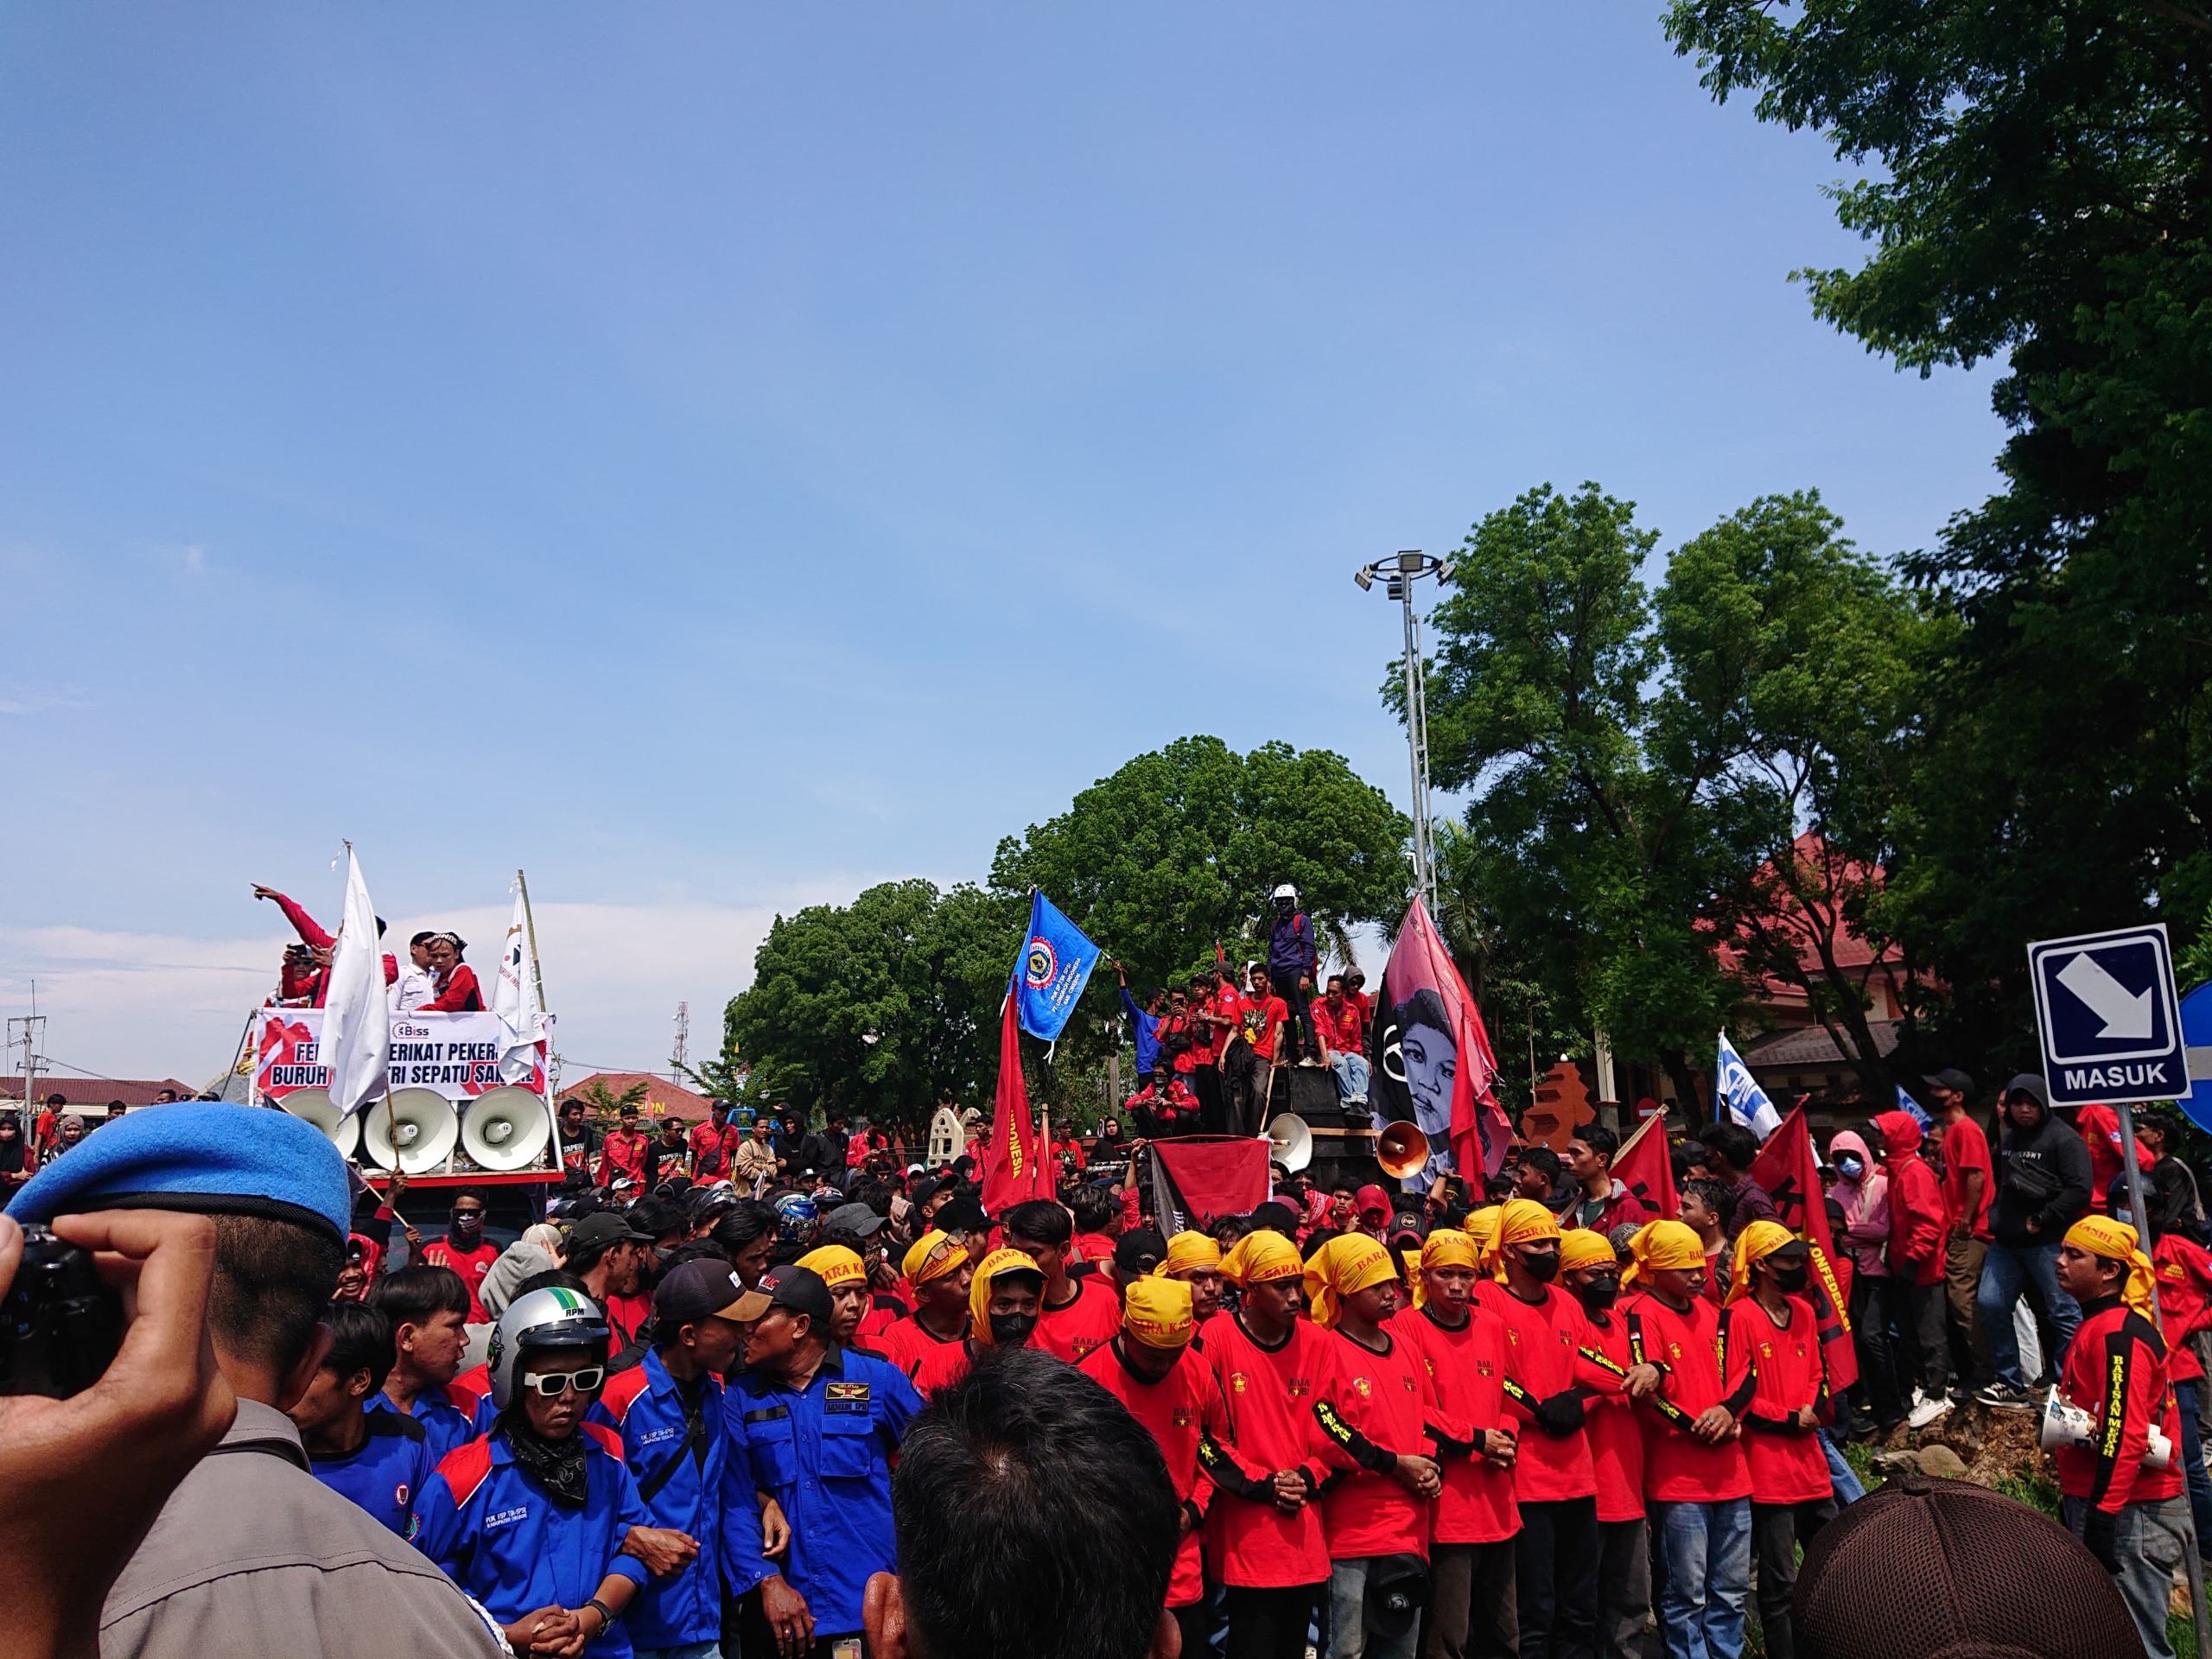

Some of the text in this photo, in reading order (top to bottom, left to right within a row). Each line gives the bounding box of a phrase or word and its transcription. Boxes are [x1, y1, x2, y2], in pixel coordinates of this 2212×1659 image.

[404, 1026, 429, 1036] Biss
[388, 1043, 443, 1061] ERIKAT
[272, 1066, 327, 1085] BURUH
[411, 1065, 471, 1084] SEPATU
[2064, 1063, 2168, 1090] MASUK
[1518, 1224, 1546, 1240] BARA
[988, 1249, 1019, 1268] BARA
[1357, 1249, 1389, 1271] BARA
[823, 1264, 851, 1281] ARA
[566, 1308, 585, 1318] RPM
[1072, 1336, 1099, 1346] BARA
[2102, 1355, 2124, 1459] BARISAN MERAH
